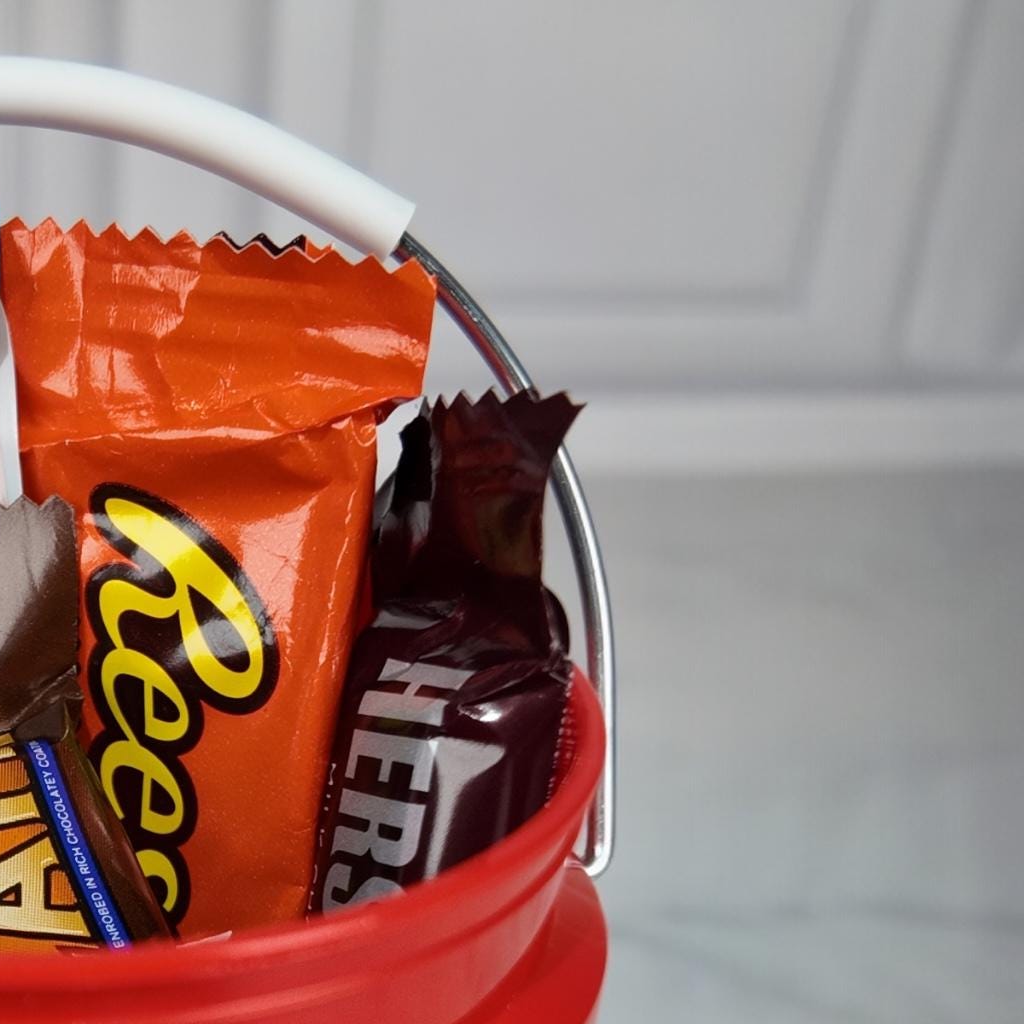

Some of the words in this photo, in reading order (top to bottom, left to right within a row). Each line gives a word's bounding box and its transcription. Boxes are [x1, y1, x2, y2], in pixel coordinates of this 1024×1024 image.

[41, 770, 80, 845] CHOCOLATEY
[73, 848, 91, 875] RICH
[84, 876, 98, 890] IN
[90, 891, 126, 949] ENROBED
